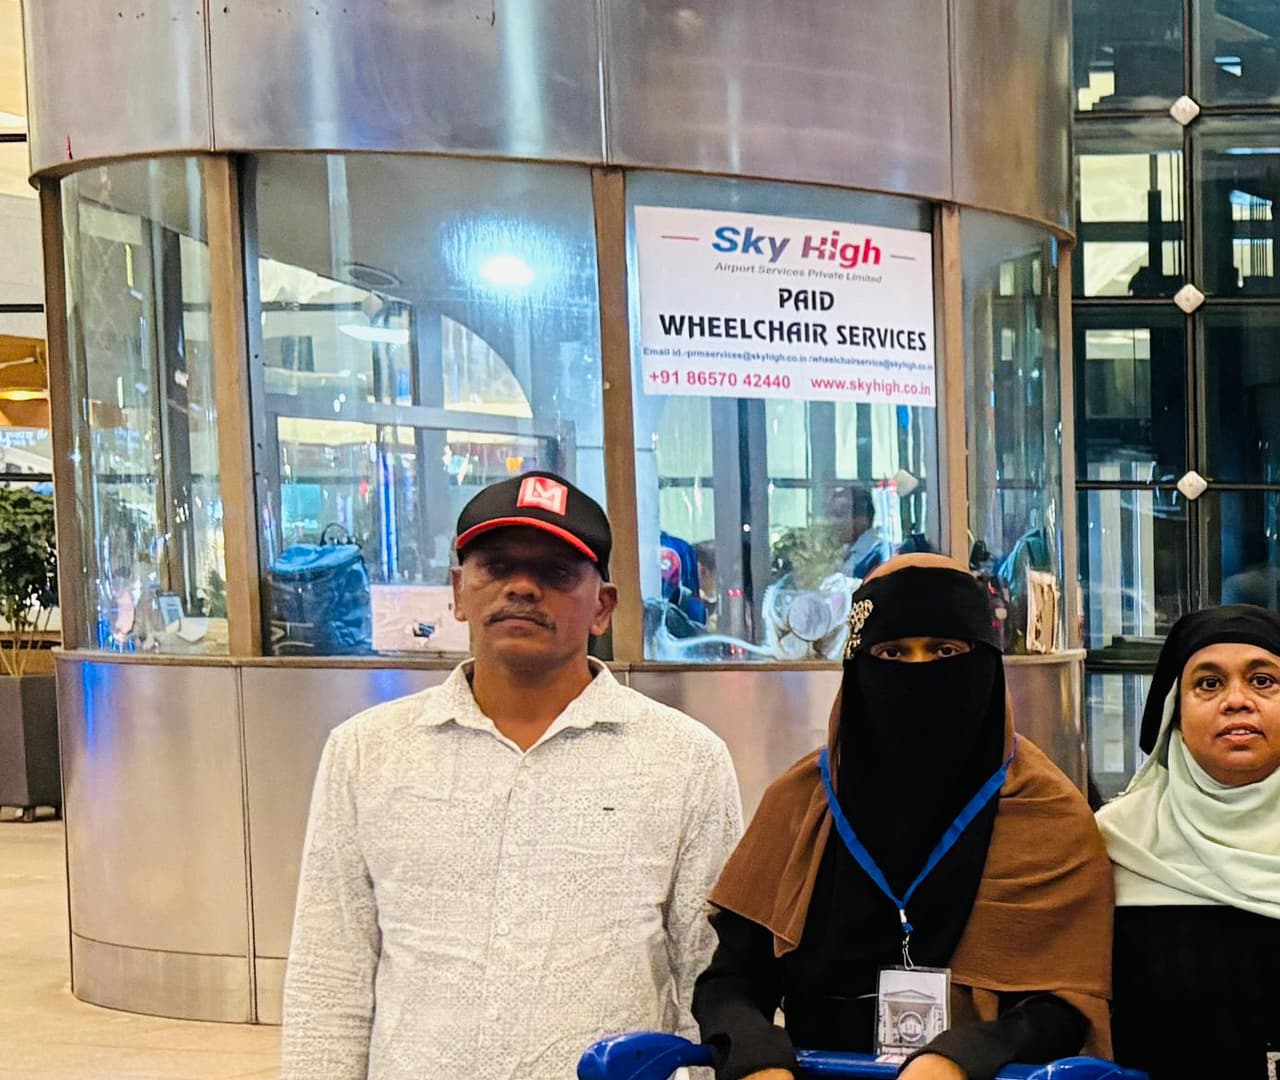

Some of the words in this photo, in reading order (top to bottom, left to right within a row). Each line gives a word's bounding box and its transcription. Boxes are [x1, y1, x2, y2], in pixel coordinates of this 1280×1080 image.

[711, 226, 791, 263] Sky
[800, 230, 882, 269] High
[714, 261, 755, 274] Airport
[757, 265, 805, 277] Services
[807, 268, 844, 281] Private
[846, 273, 883, 284] Limited
[778, 287, 835, 312] PAID
[659, 313, 828, 346] WHEELCHAIR
[836, 324, 927, 352] SERVICES
[649, 370, 680, 385] +91
[686, 371, 737, 388] 86570
[743, 373, 791, 390] 42440
[810, 376, 932, 397] www.skyhigh.co.in
